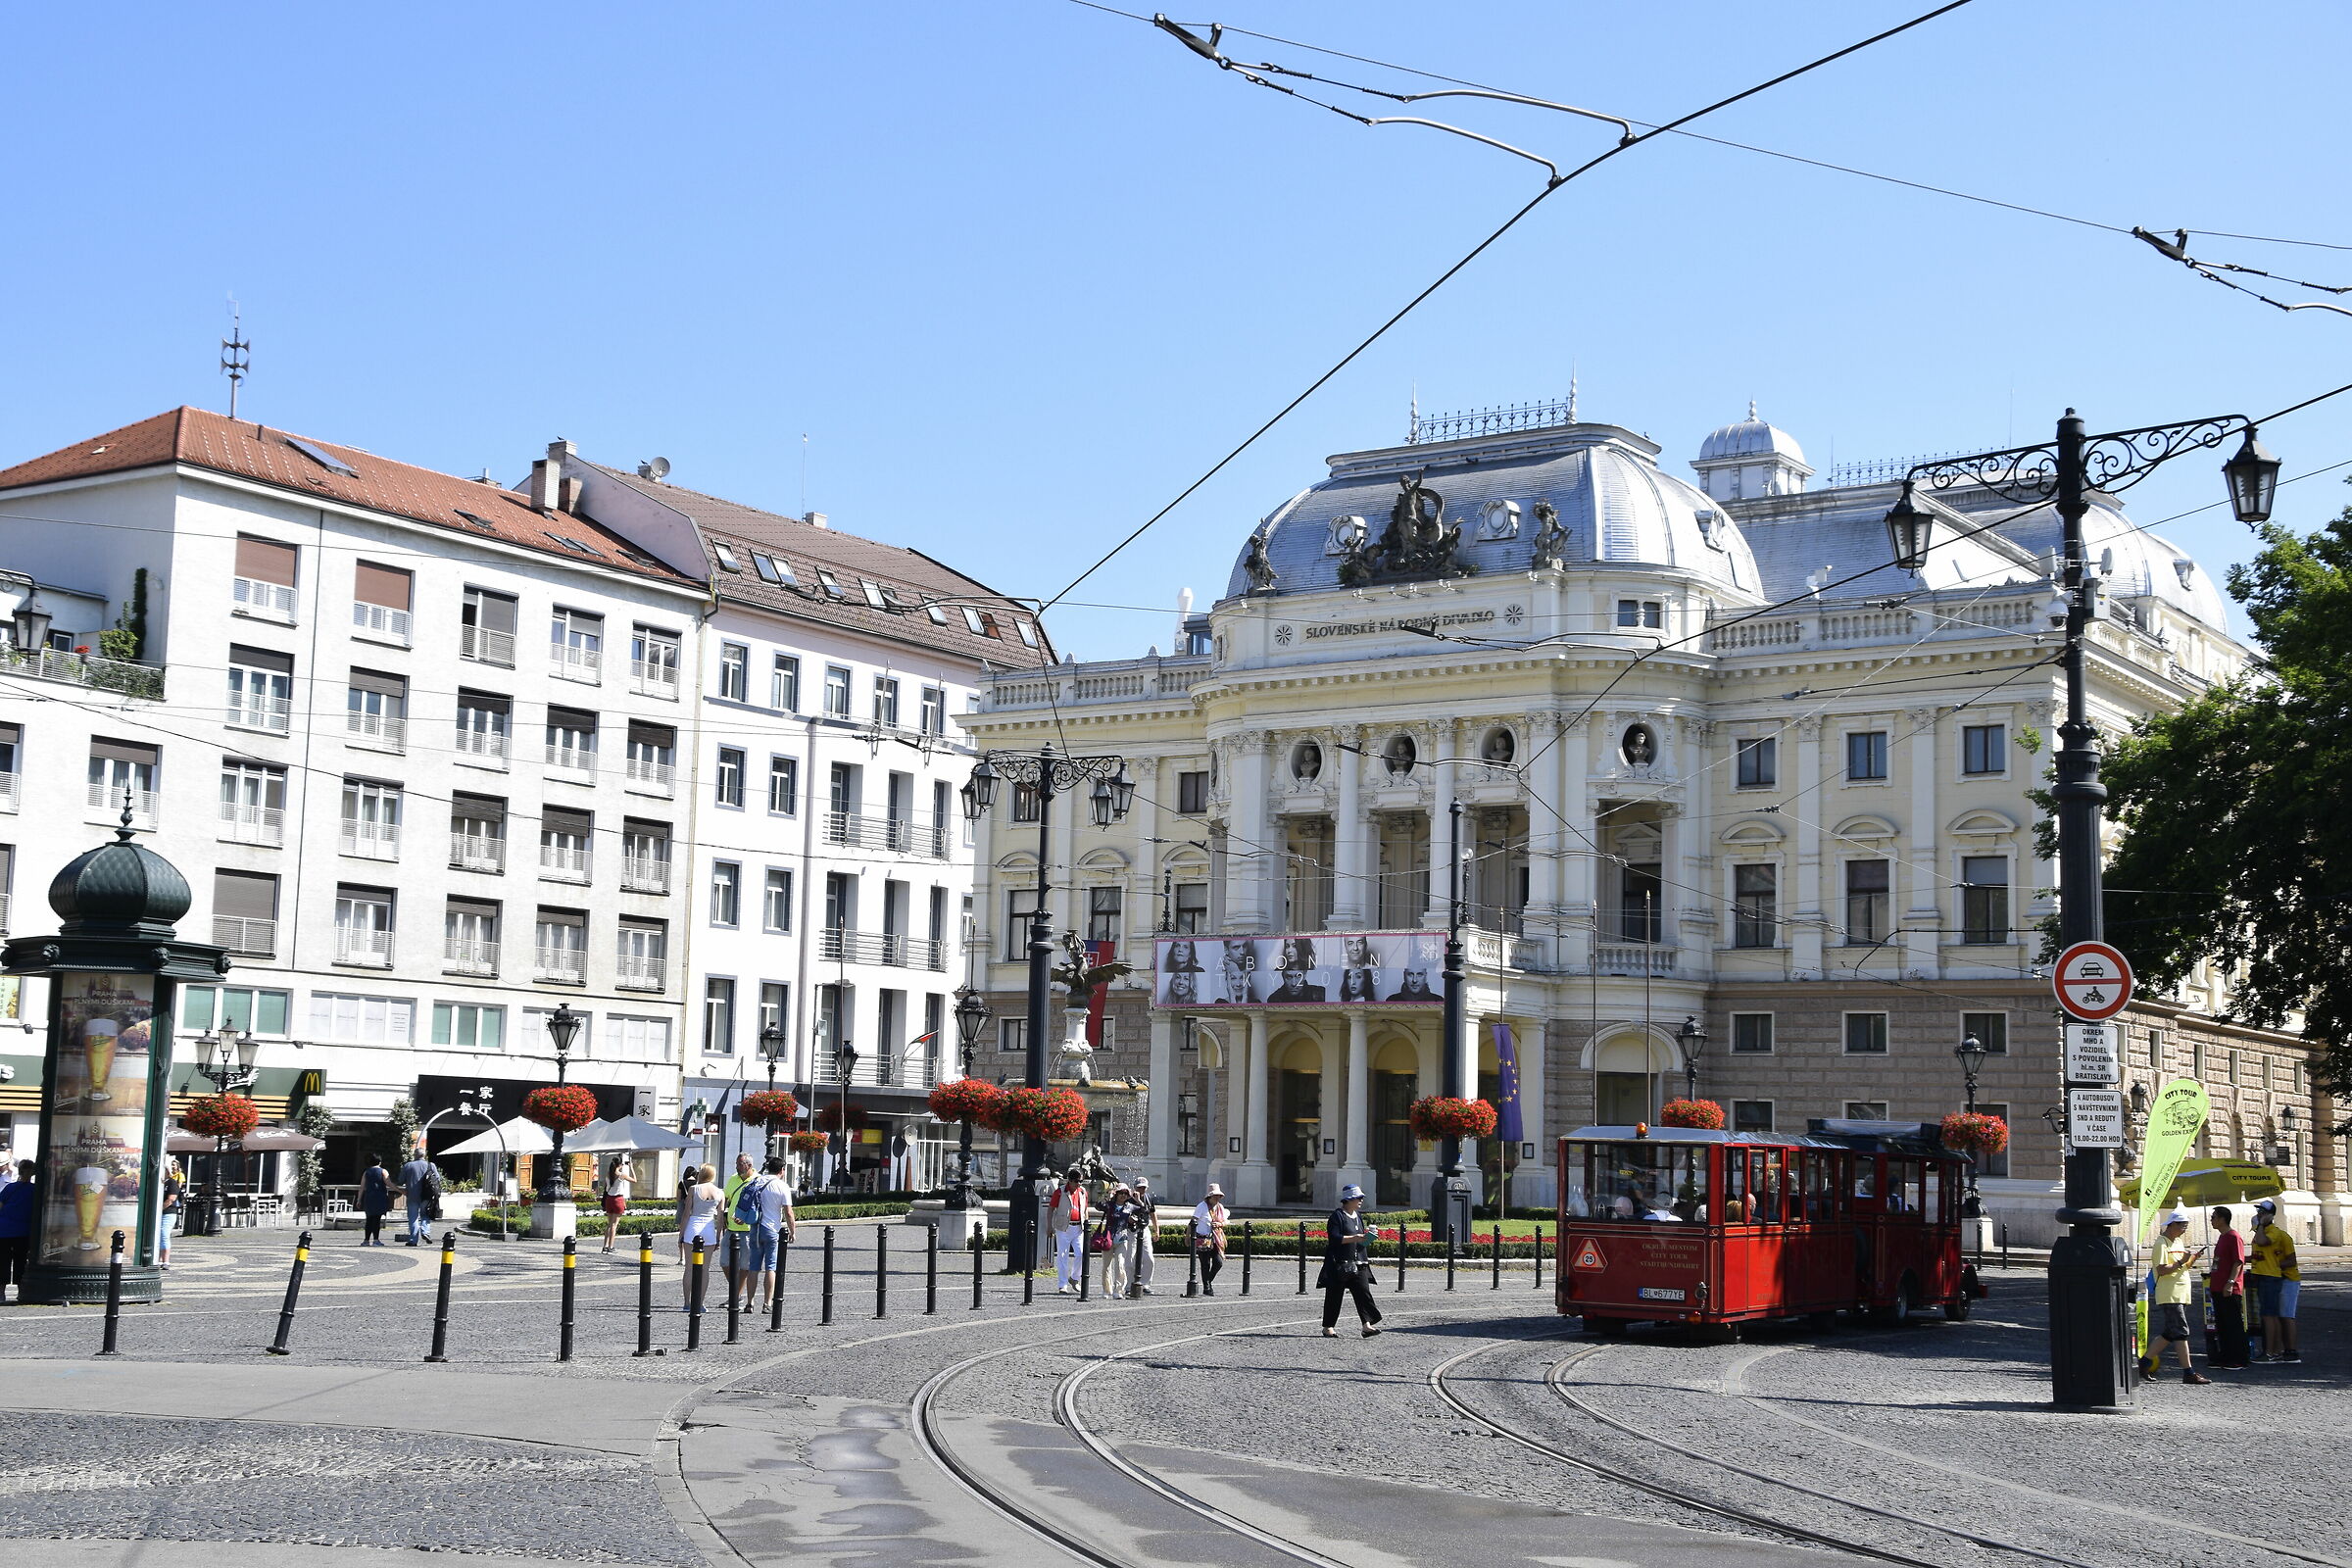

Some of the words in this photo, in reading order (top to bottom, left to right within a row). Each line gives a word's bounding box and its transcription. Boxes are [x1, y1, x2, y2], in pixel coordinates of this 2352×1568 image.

[1305, 618, 1376, 640] SLOVENSKÉ
[1443, 610, 1495, 626] DIVADLO
[2079, 1046, 2108, 1054] VOZIDIEL
[2075, 1072, 2112, 1081] BRATISLAVY
[2164, 1090, 2179, 1100] CITY
[2180, 1089, 2198, 1099] TOUR
[2091, 1123, 2107, 1132] ČASE
